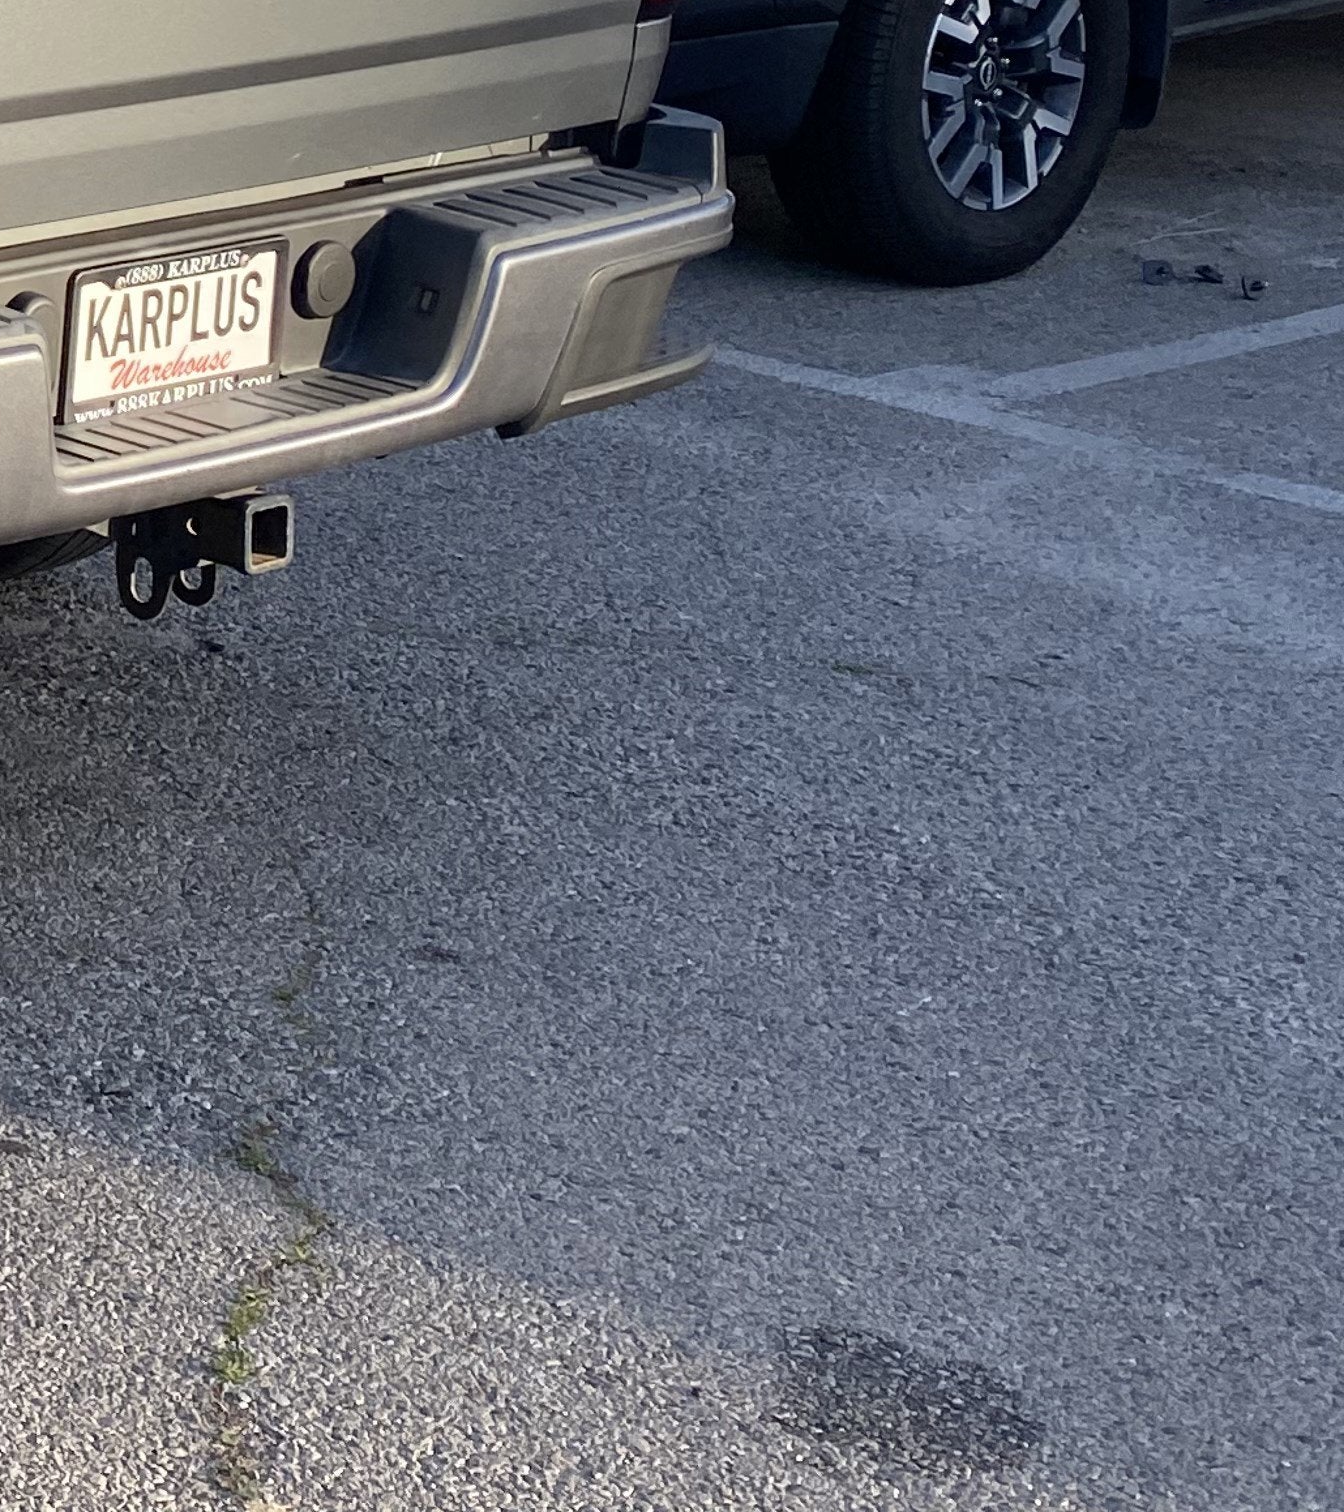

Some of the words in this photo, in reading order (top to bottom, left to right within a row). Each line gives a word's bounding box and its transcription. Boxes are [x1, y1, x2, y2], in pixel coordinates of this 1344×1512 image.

[126, 263, 165, 285] (888)
[166, 250, 242, 280] KARPLUS
[84, 270, 263, 362] KARPLUS
[109, 345, 232, 391] Warehouse
